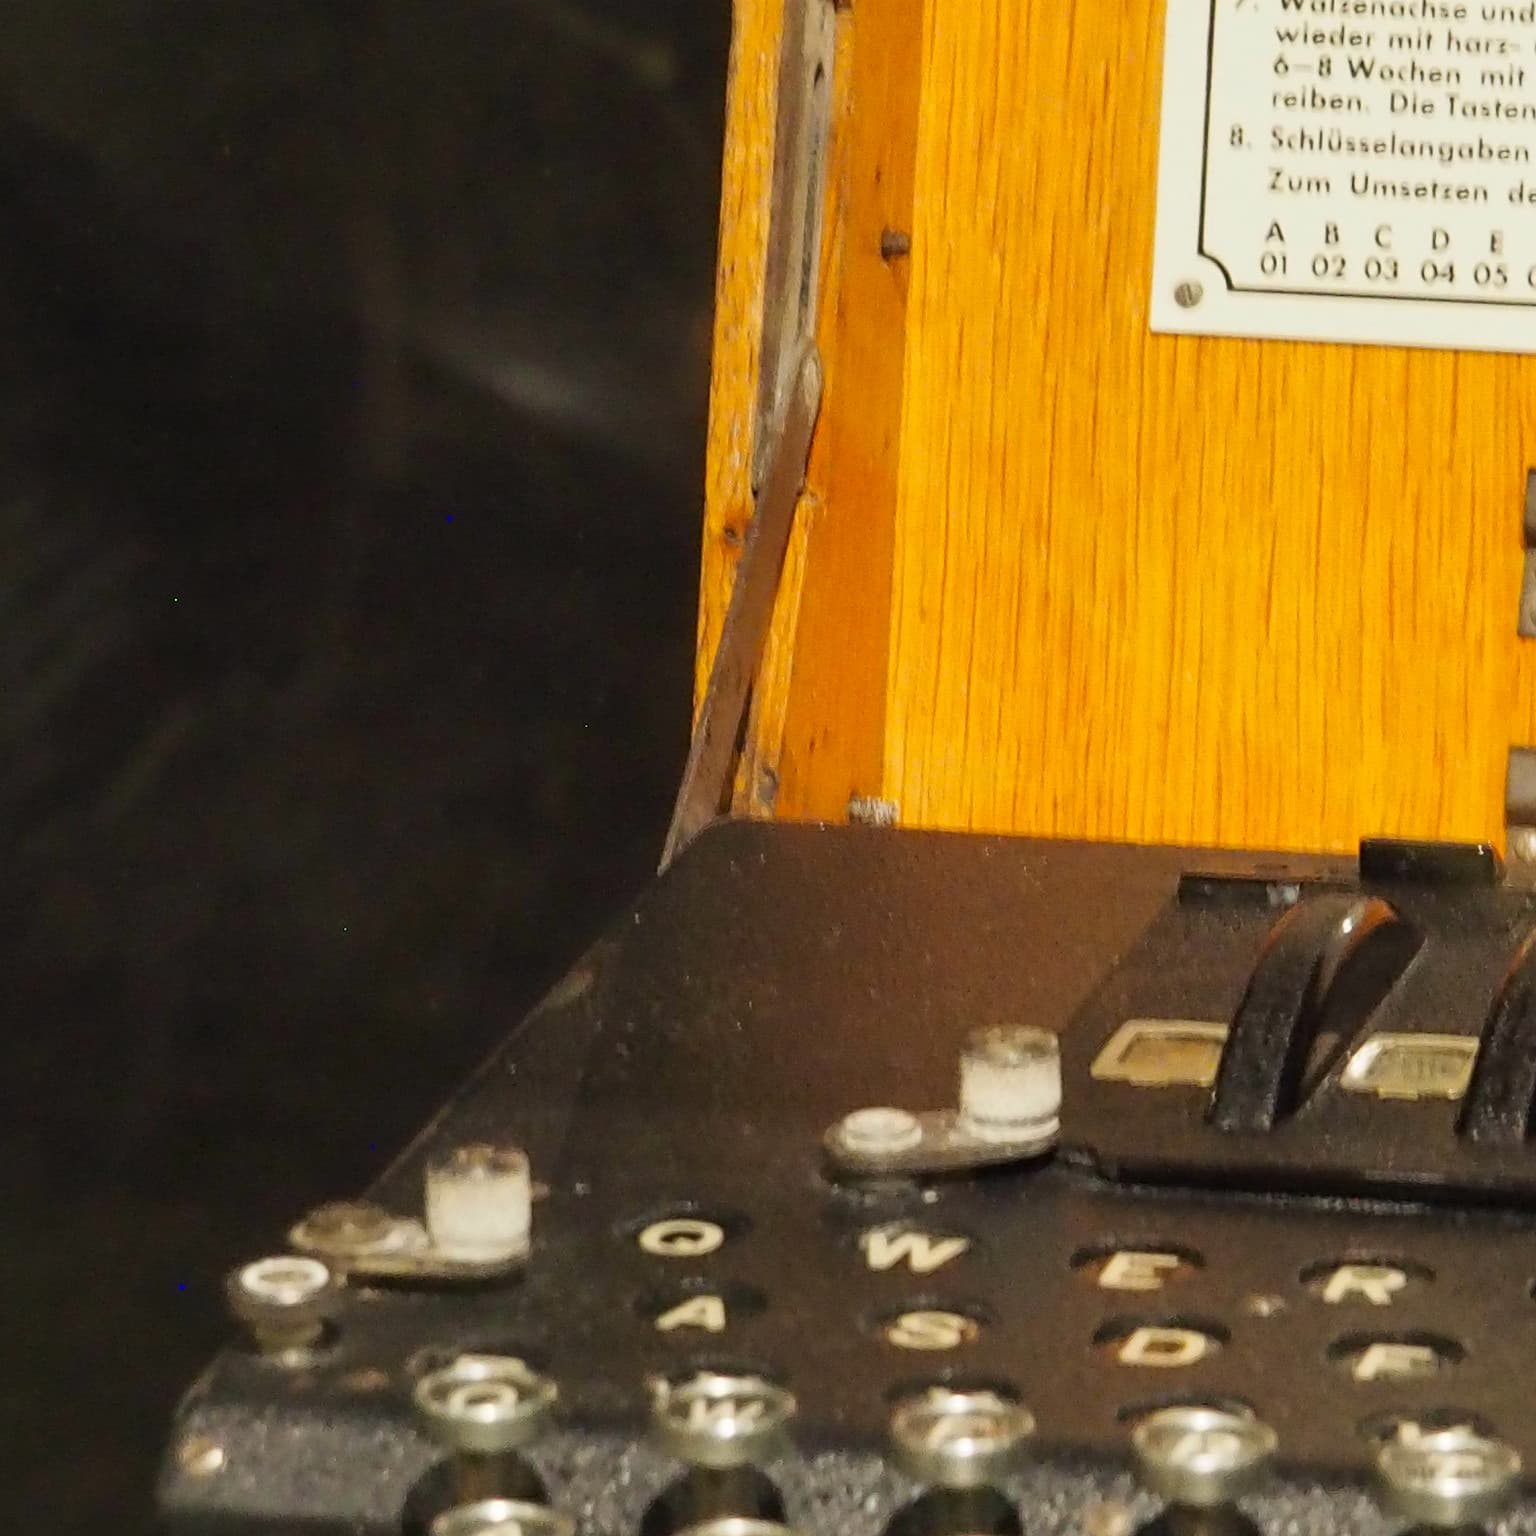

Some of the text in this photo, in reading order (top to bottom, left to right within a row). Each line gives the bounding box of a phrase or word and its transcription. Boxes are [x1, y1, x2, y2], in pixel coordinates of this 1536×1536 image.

[1227, 122, 1252, 150] 8.
[1269, 123, 1531, 167] Schlüsselangaben
[860, 1225, 967, 1274] W
[1321, 1265, 1408, 1307] R
[656, 1294, 728, 1333] A
[886, 1310, 969, 1351] S
[1117, 1326, 1211, 1368] D
